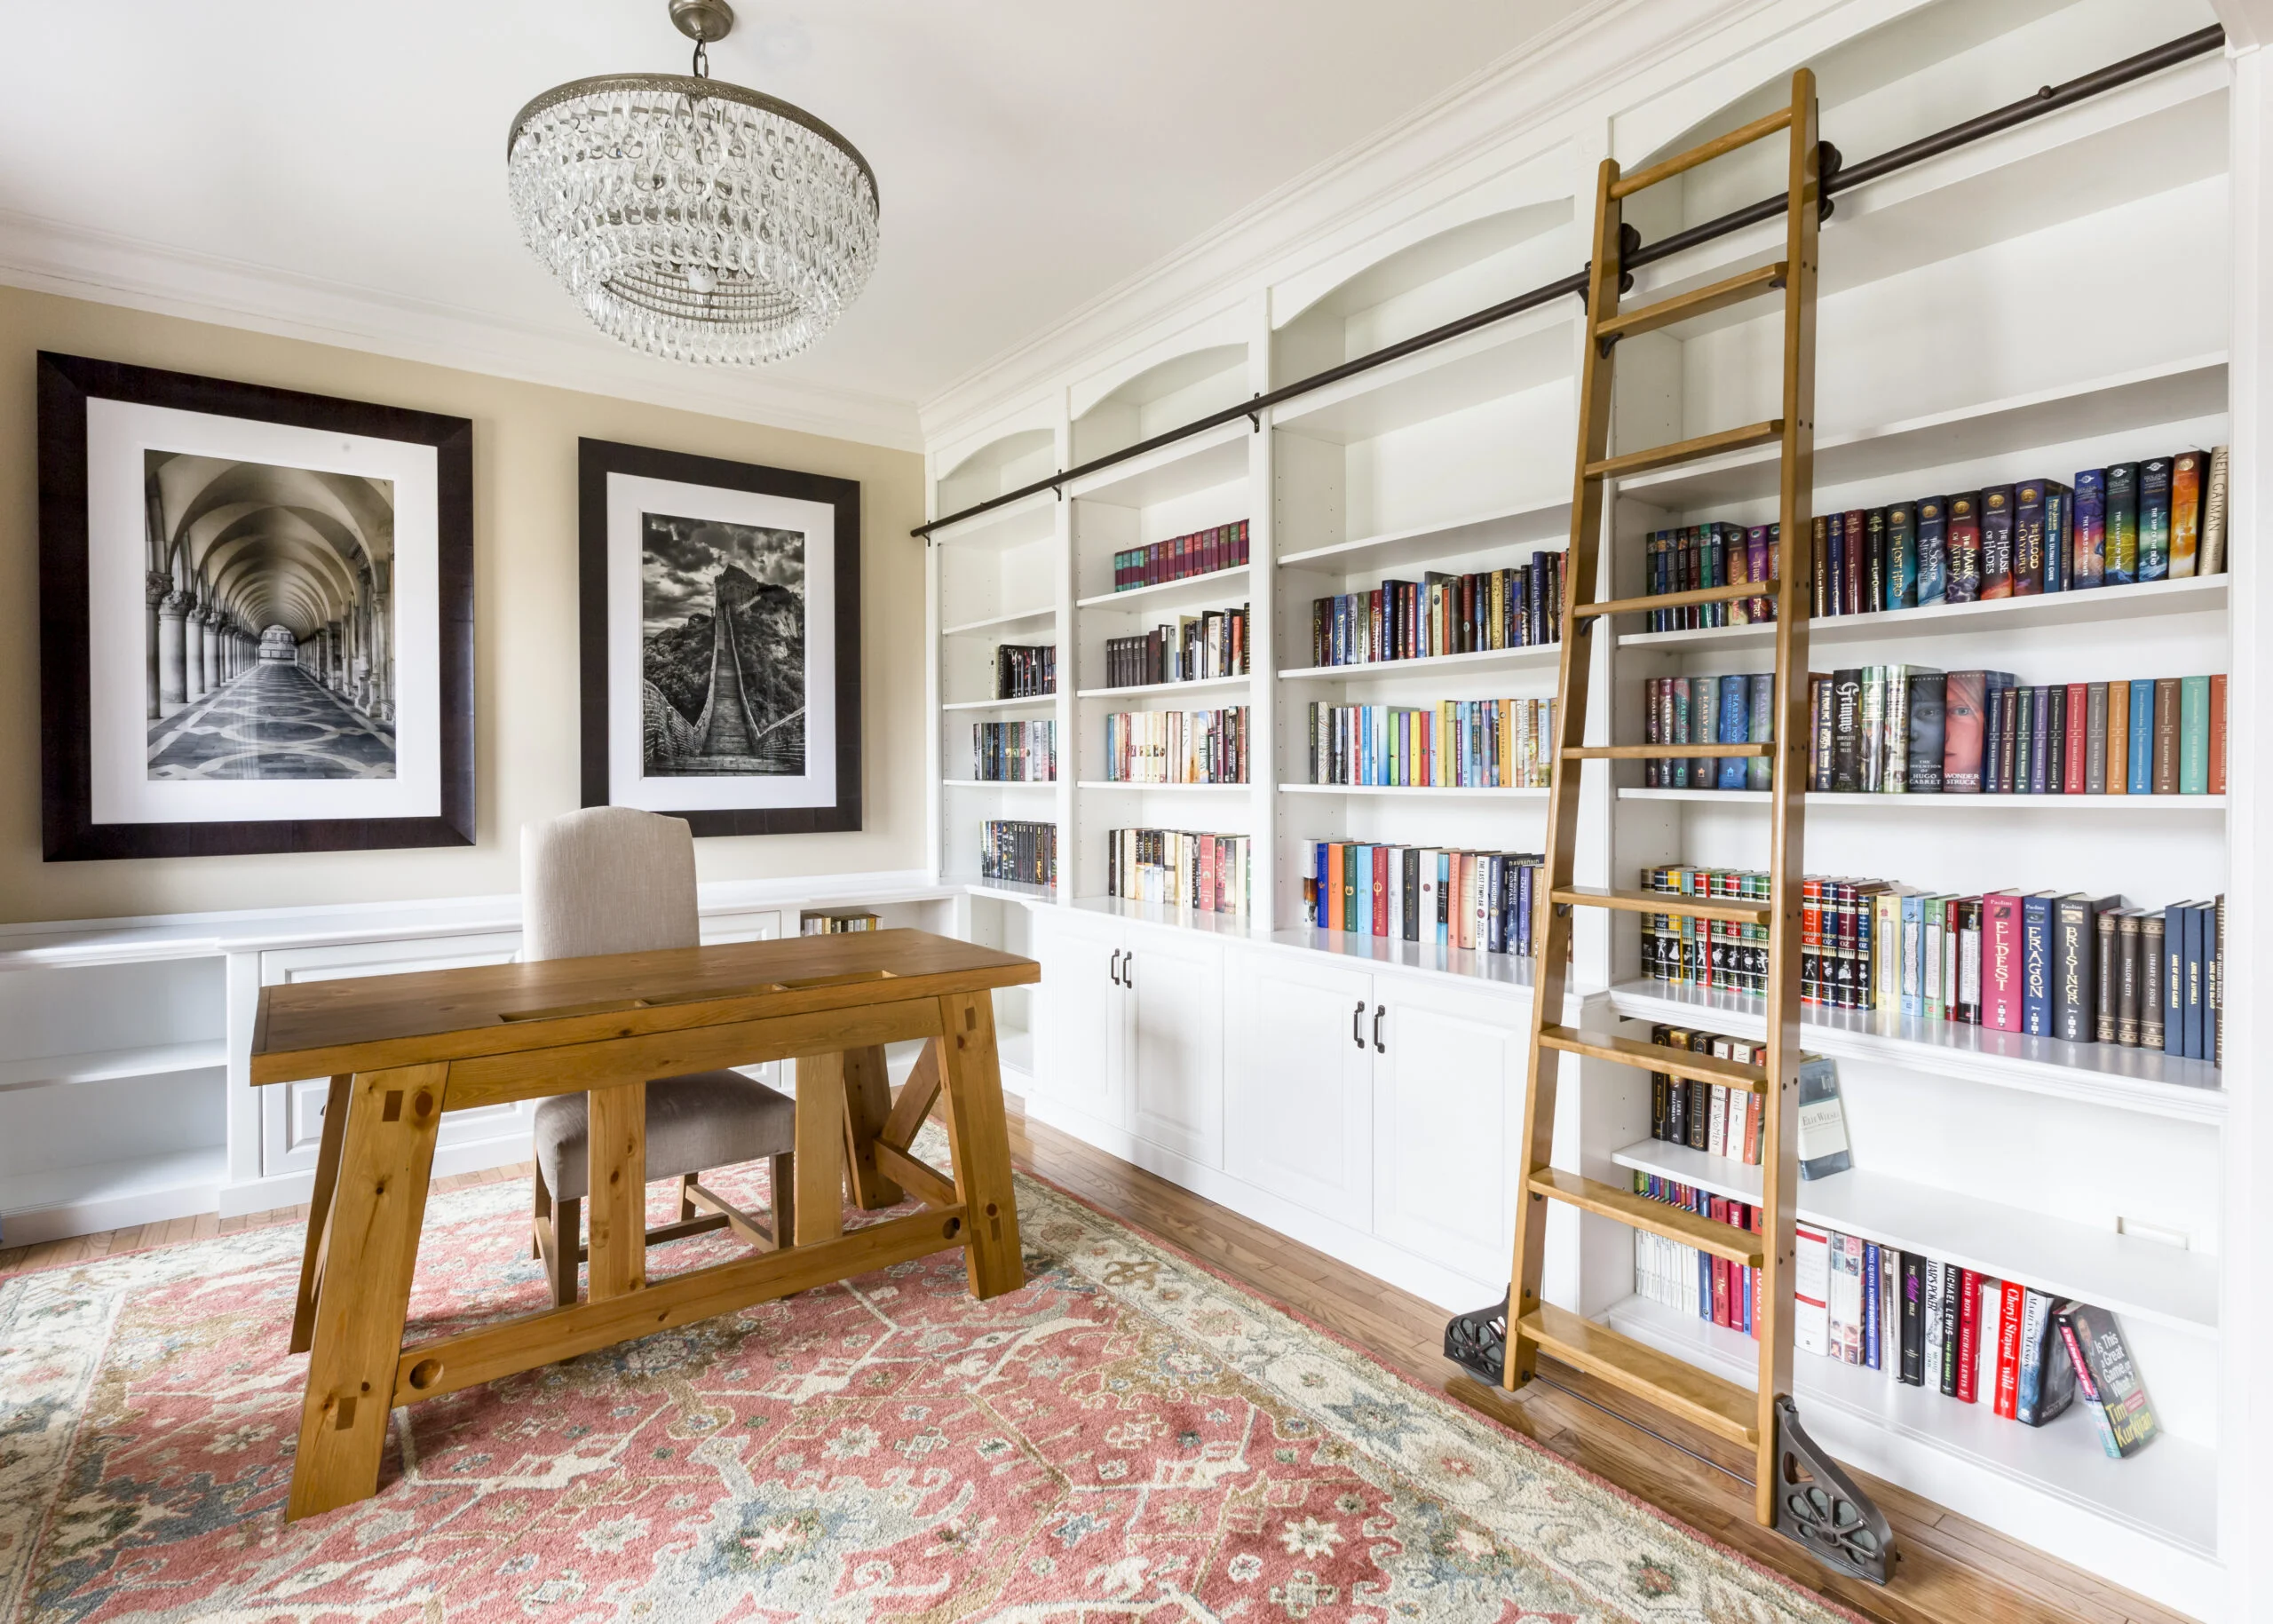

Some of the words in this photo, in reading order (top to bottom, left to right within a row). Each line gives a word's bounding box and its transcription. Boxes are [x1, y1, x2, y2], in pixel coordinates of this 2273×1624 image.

[2216, 451, 2228, 479] NEIL
[2209, 482, 2224, 532] GAIMAN
[1892, 546, 1904, 568] LOST
[1963, 547, 1976, 580] MARK
[1984, 540, 1995, 574] HADES
[1997, 541, 2011, 574] HOUSE
[2029, 534, 2040, 569] BLOOD
[1892, 570, 1904, 598] HERO
[1994, 921, 2009, 991] ELDEST
[2028, 926, 2045, 999] ERAGON
[2065, 926, 2079, 1005] BRISINGR
[1928, 1283, 1937, 1311] POKER
[1946, 1267, 1955, 1304] MICHAEL
[2003, 1288, 2019, 1320] Cheryl
[2000, 1322, 2017, 1359] Strayed
[2095, 1340, 2104, 1354] Is
[2101, 1331, 2119, 1348] This
[2103, 1345, 2125, 1365] Great
[2001, 1367, 2013, 1390] wild
[2105, 1403, 2128, 1425] Tim
